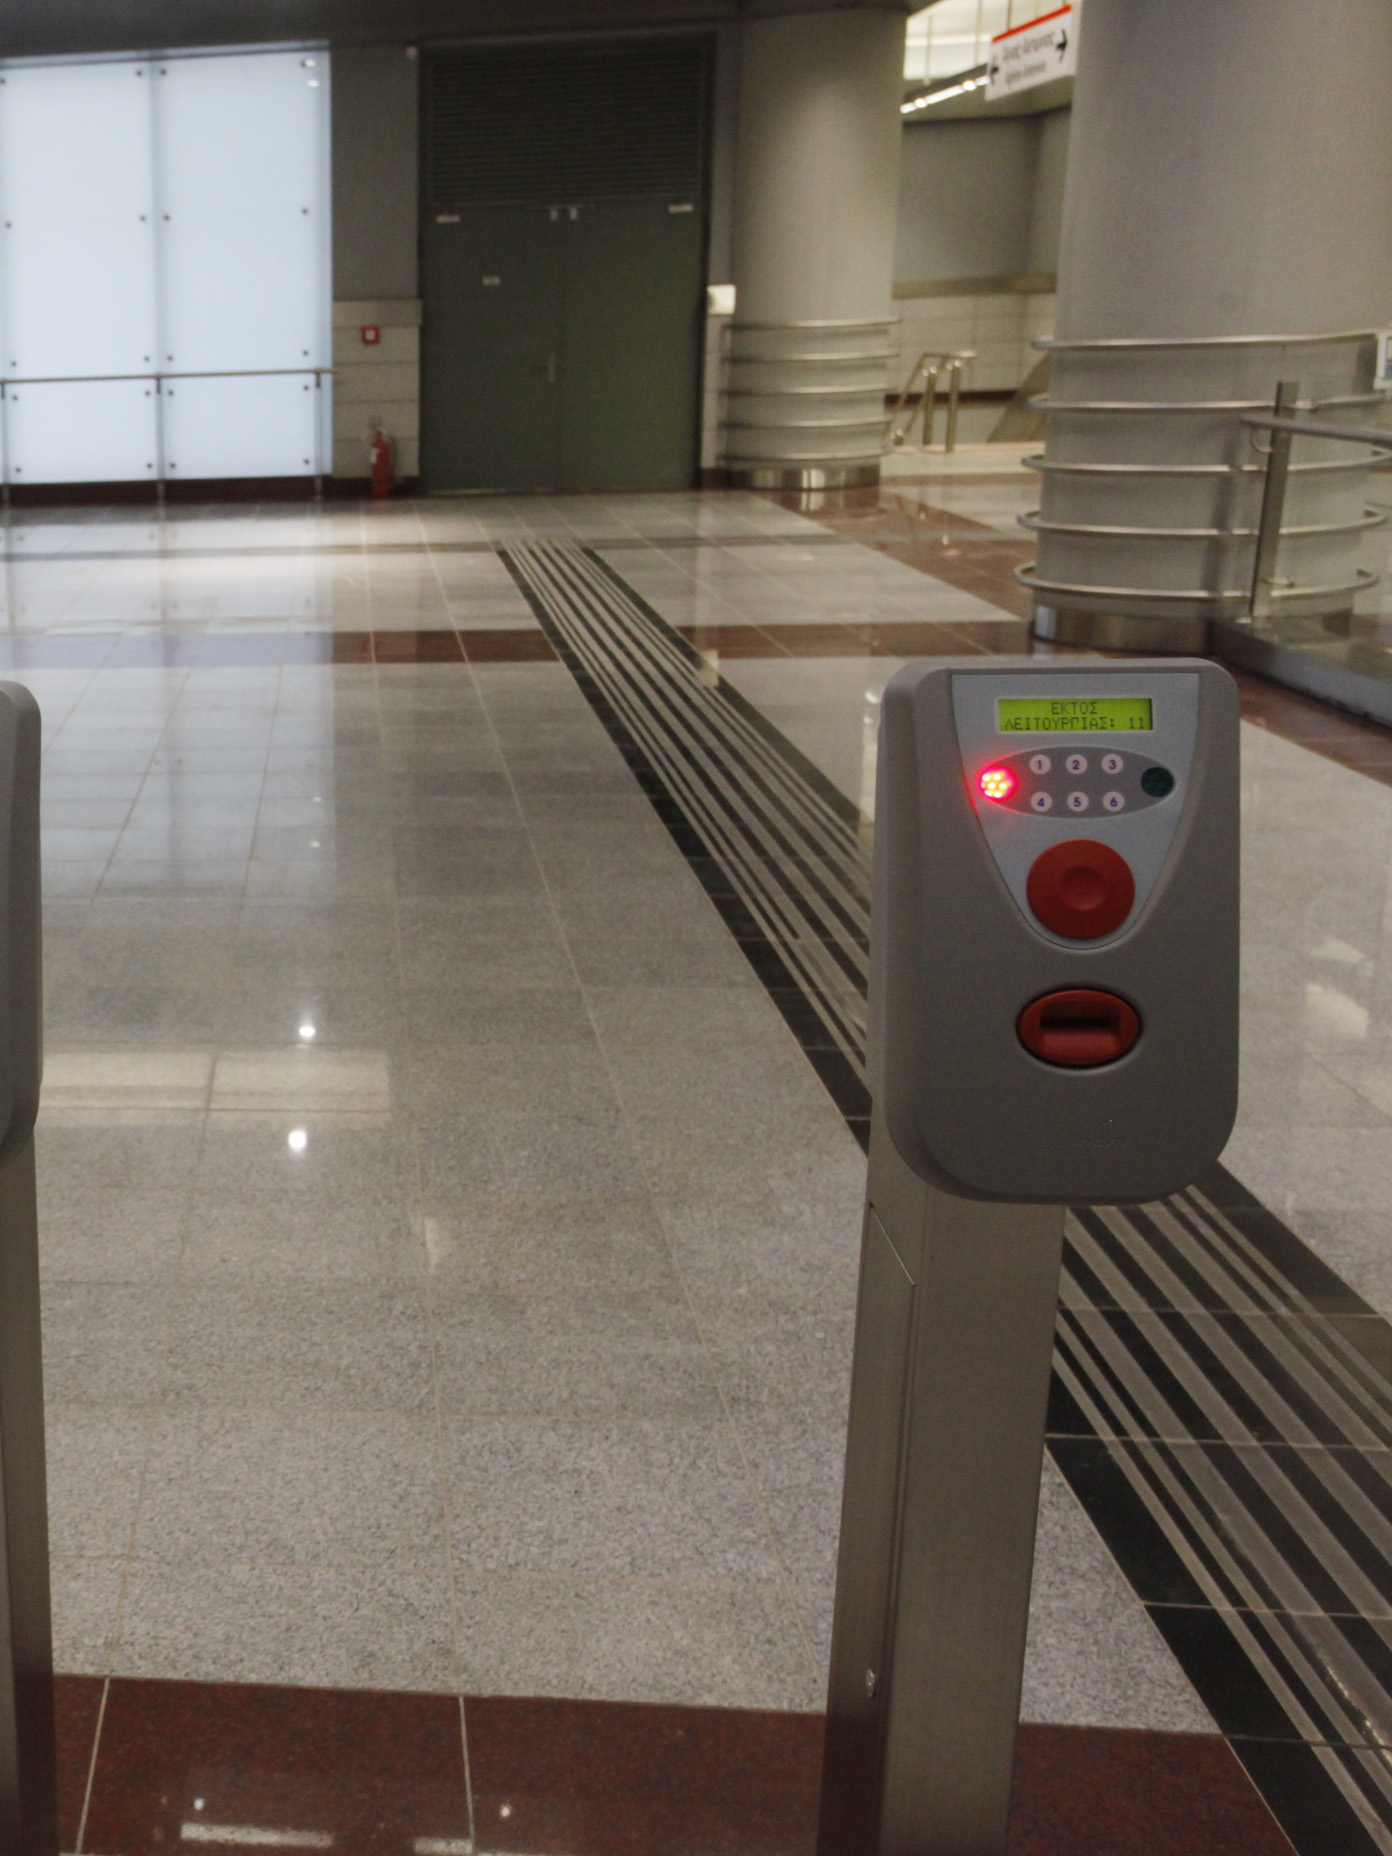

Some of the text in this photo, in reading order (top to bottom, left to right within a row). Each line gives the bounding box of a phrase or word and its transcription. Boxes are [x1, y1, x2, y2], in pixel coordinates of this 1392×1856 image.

[1051, 701, 1098, 715] ΕΚΤΟΣ
[1129, 717, 1145, 730] 11
[1072, 759, 1080, 770] 2
[1109, 759, 1117, 770] 3
[1037, 797, 1118, 807] 4 5 6
